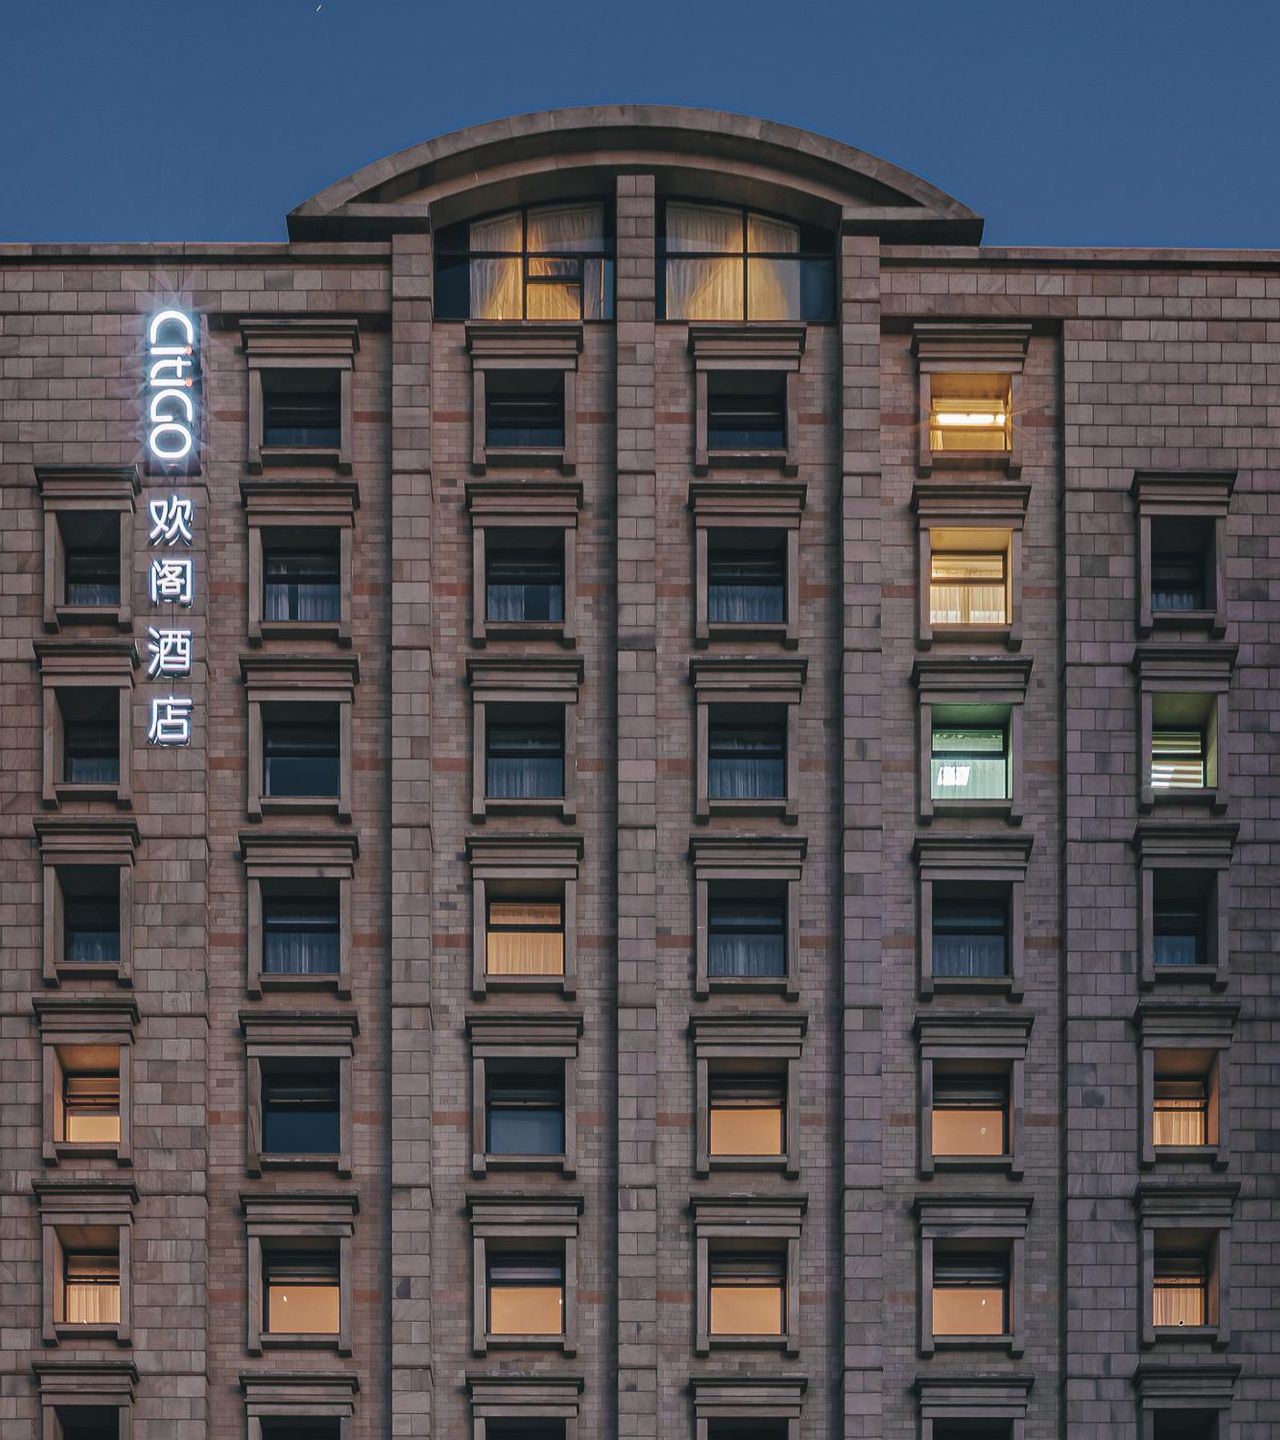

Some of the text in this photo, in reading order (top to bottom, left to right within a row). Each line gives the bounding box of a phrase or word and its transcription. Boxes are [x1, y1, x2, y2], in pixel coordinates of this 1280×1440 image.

[149, 310, 194, 460] CitiGO
[147, 495, 194, 746] 欢阁酒店
